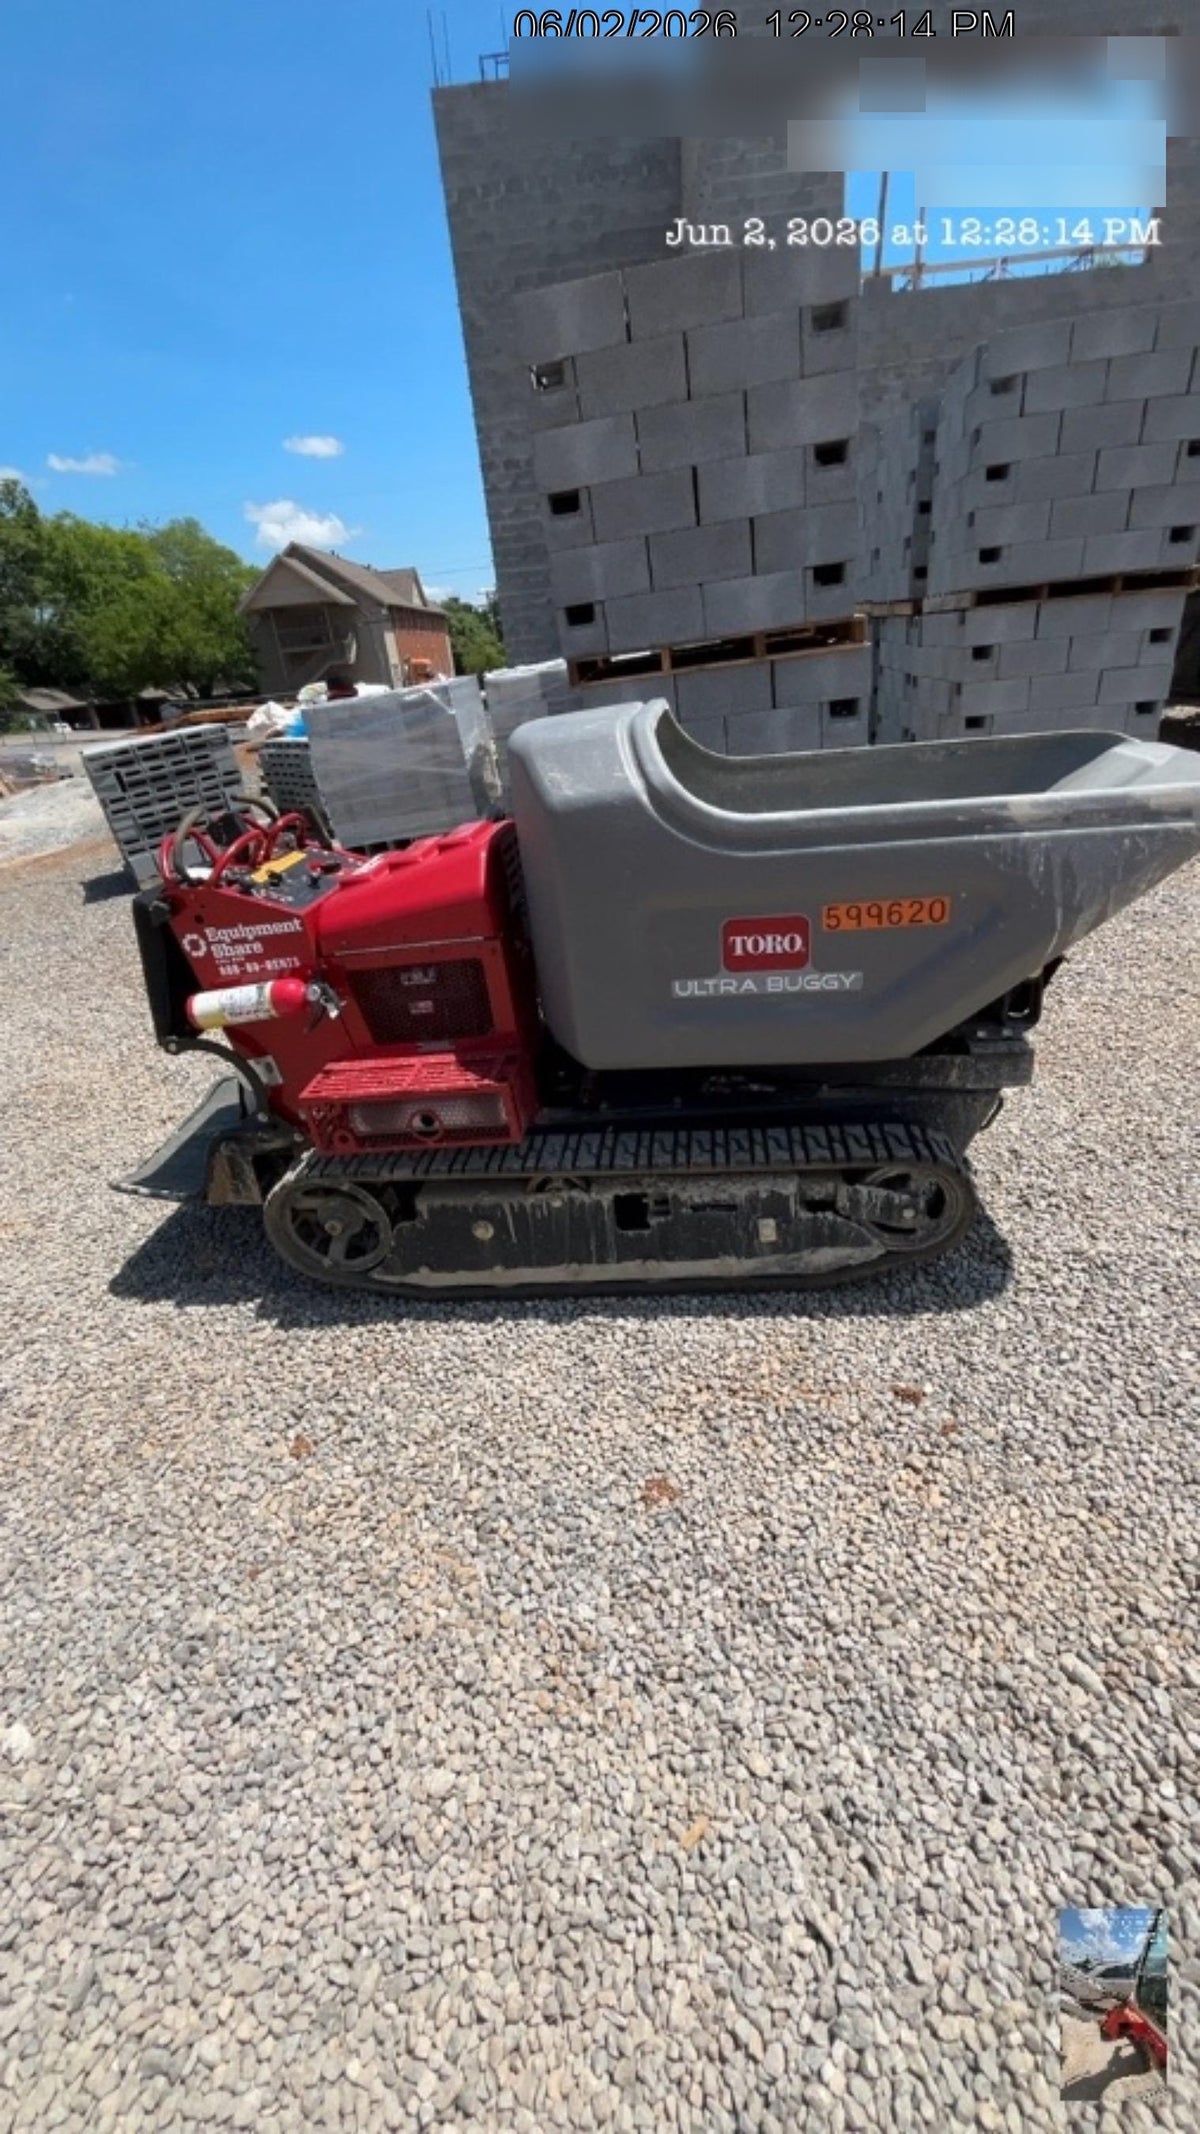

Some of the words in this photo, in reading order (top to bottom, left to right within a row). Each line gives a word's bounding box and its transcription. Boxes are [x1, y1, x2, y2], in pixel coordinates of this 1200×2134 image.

[824, 898, 947, 930] 599620
[204, 918, 303, 943] Equipment
[211, 942, 264, 958] Share
[728, 933, 803, 956] TORO
[674, 978, 757, 997] ULTRA
[766, 973, 856, 992] BUGGY
